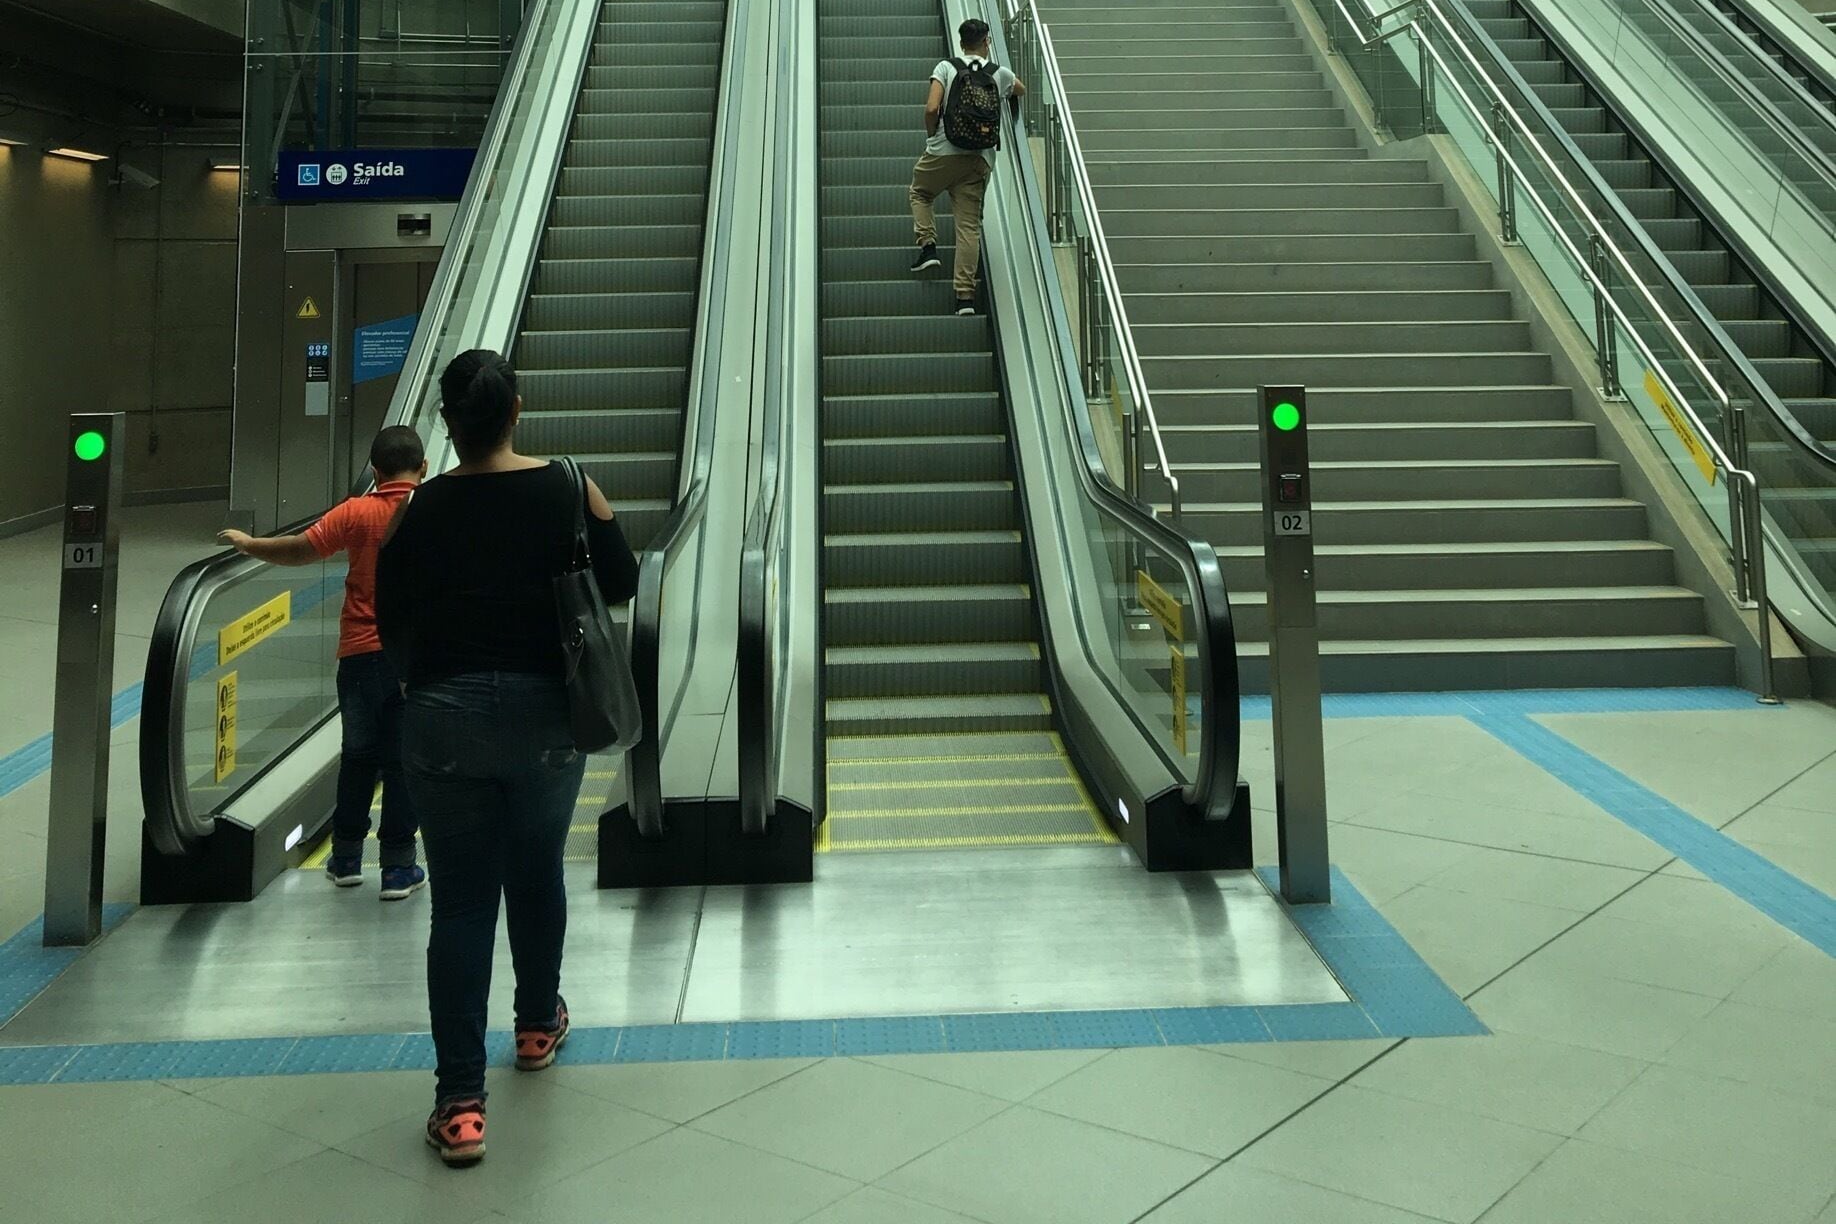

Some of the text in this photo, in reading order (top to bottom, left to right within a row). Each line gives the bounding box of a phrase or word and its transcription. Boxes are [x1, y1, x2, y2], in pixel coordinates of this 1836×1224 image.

[353, 162, 404, 176] Saída
[353, 177, 370, 185] Exit
[1282, 515, 1303, 530] 02
[73, 547, 93, 563] 01
